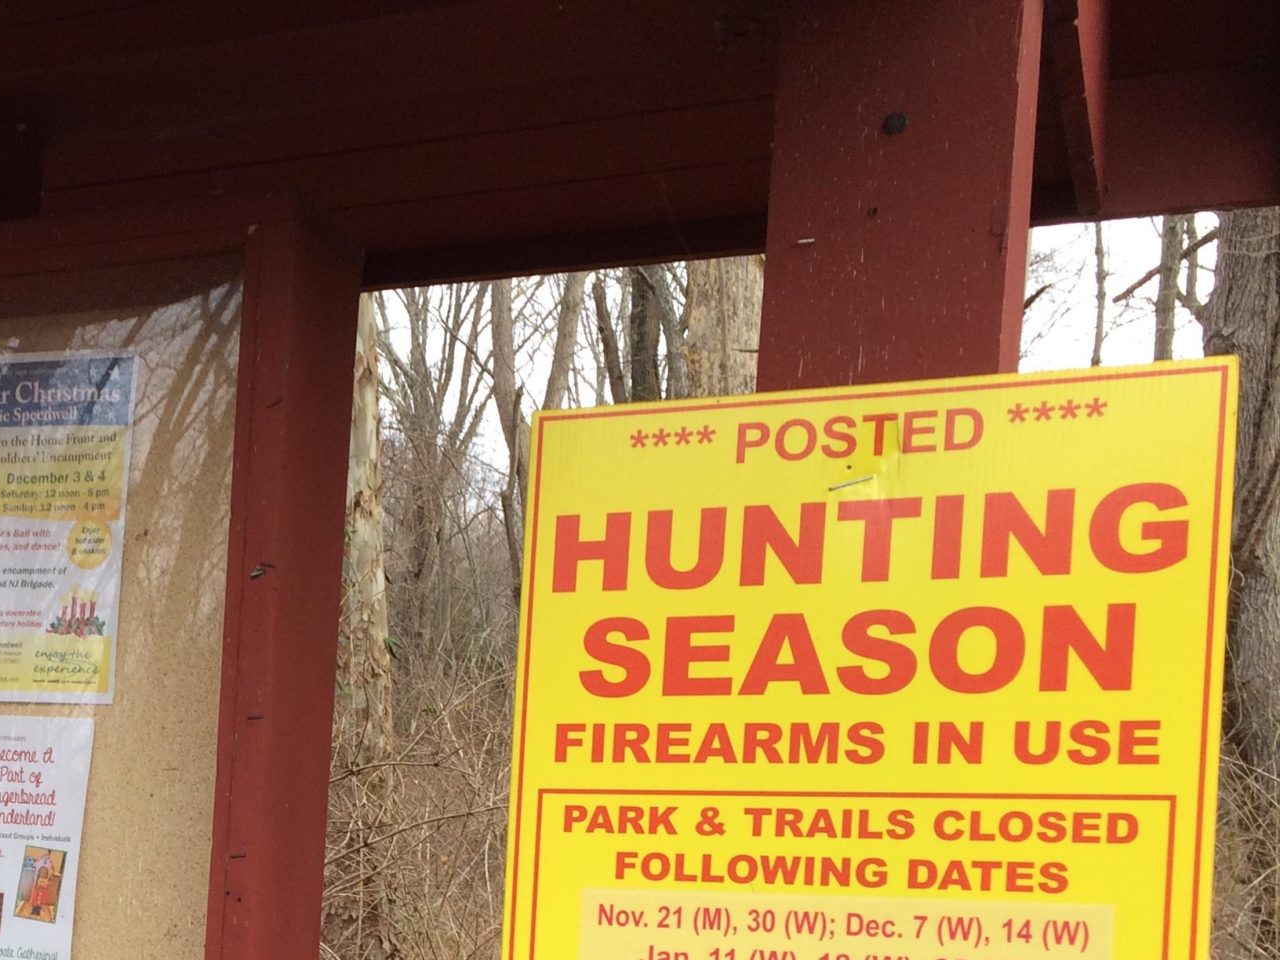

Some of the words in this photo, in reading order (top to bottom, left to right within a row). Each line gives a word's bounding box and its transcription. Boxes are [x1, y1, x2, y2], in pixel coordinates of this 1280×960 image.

[15, 381, 120, 405] Christmas
[13, 406, 78, 424] Speedwell
[11, 435, 27, 446] the
[32, 435, 62, 445] Home
[66, 433, 94, 445] Front
[98, 432, 116, 443] and
[736, 408, 984, 464] POSTED
[7, 471, 68, 484] December
[73, 472, 80, 483] 3
[85, 472, 93, 482] &
[98, 470, 106, 482] 4
[0, 490, 42, 500] Saturday:
[46, 490, 55, 498] 12
[3, 503, 37, 513] Sunday:
[40, 503, 51, 511] 12
[13, 529, 30, 538] Ball
[552, 482, 1190, 593] HUNTING
[13, 542, 29, 551] and
[31, 542, 61, 551] dance!
[2, 567, 56, 577] encampment
[57, 567, 67, 575] of
[9, 580, 19, 588] NJ
[20, 580, 55, 590] Brigade.
[579, 603, 1136, 698] SEASON
[554, 721, 885, 765] FIREARMS
[913, 721, 984, 764] IN
[1014, 720, 1161, 766] USE
[0, 766, 25, 783] Part
[29, 772, 43, 787] of
[563, 804, 679, 836] PARK
[694, 806, 726, 837] &
[743, 807, 916, 840] TRAILS
[933, 809, 1139, 844] CLOSED
[615, 851, 888, 889] FOLLOWING
[907, 858, 1069, 895] DATES
[598, 903, 648, 928] Nov.
[656, 905, 683, 929] 21
[693, 906, 738, 937] (M),
[747, 908, 776, 934] 30
[784, 910, 835, 942] (W);
[846, 912, 903, 939] Dec.
[913, 915, 928, 939] 7
[936, 915, 990, 949] (W),
[1002, 918, 1033, 944] 14
[1041, 920, 1090, 953] (W)
